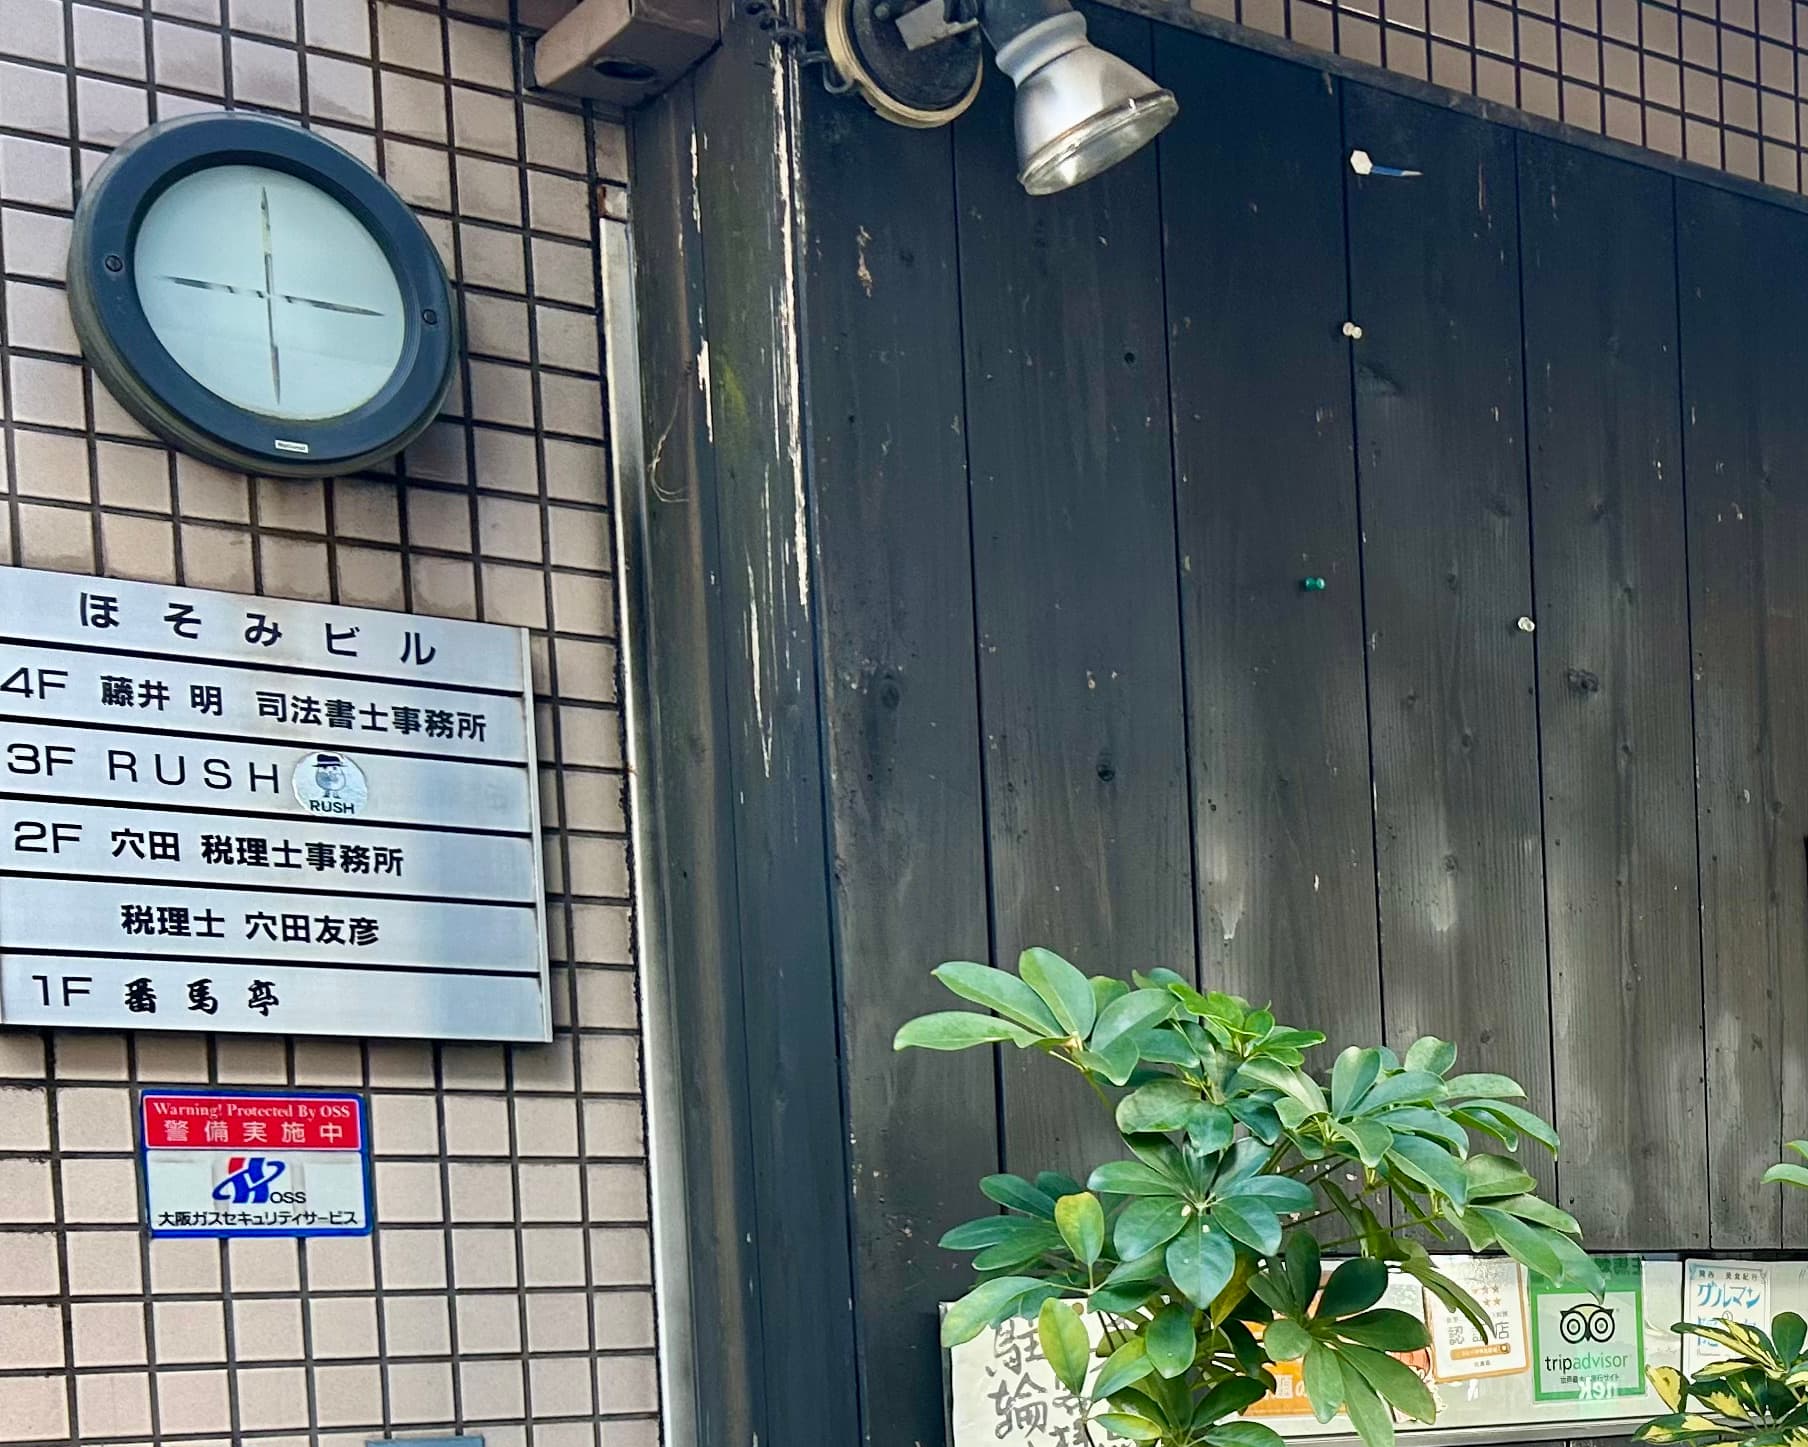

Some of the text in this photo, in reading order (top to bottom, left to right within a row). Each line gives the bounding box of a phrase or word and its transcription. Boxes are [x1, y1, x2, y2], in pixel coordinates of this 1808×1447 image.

[79, 592, 436, 665] ほそみビル
[0, 667, 487, 742] 4F 藤井 明 司法書士事務所
[6, 743, 281, 794] 3F RUSH
[309, 799, 355, 815] RUSH
[13, 821, 405, 877] 2F 穴田 税理士事務所
[120, 904, 380, 946] 税理士 穴田友彦
[32, 975, 281, 1016] 1F 番馬亭
[153, 1102, 350, 1122] Warning! Protected By OSS
[164, 1119, 343, 1144] 警備実施中
[269, 1191, 306, 1204] OSS
[158, 1210, 358, 1227] 大阪ガスセキュリティサービス
[1698, 1280, 1760, 1309] グルマン
[1545, 1353, 1628, 1372] tripadvisor
